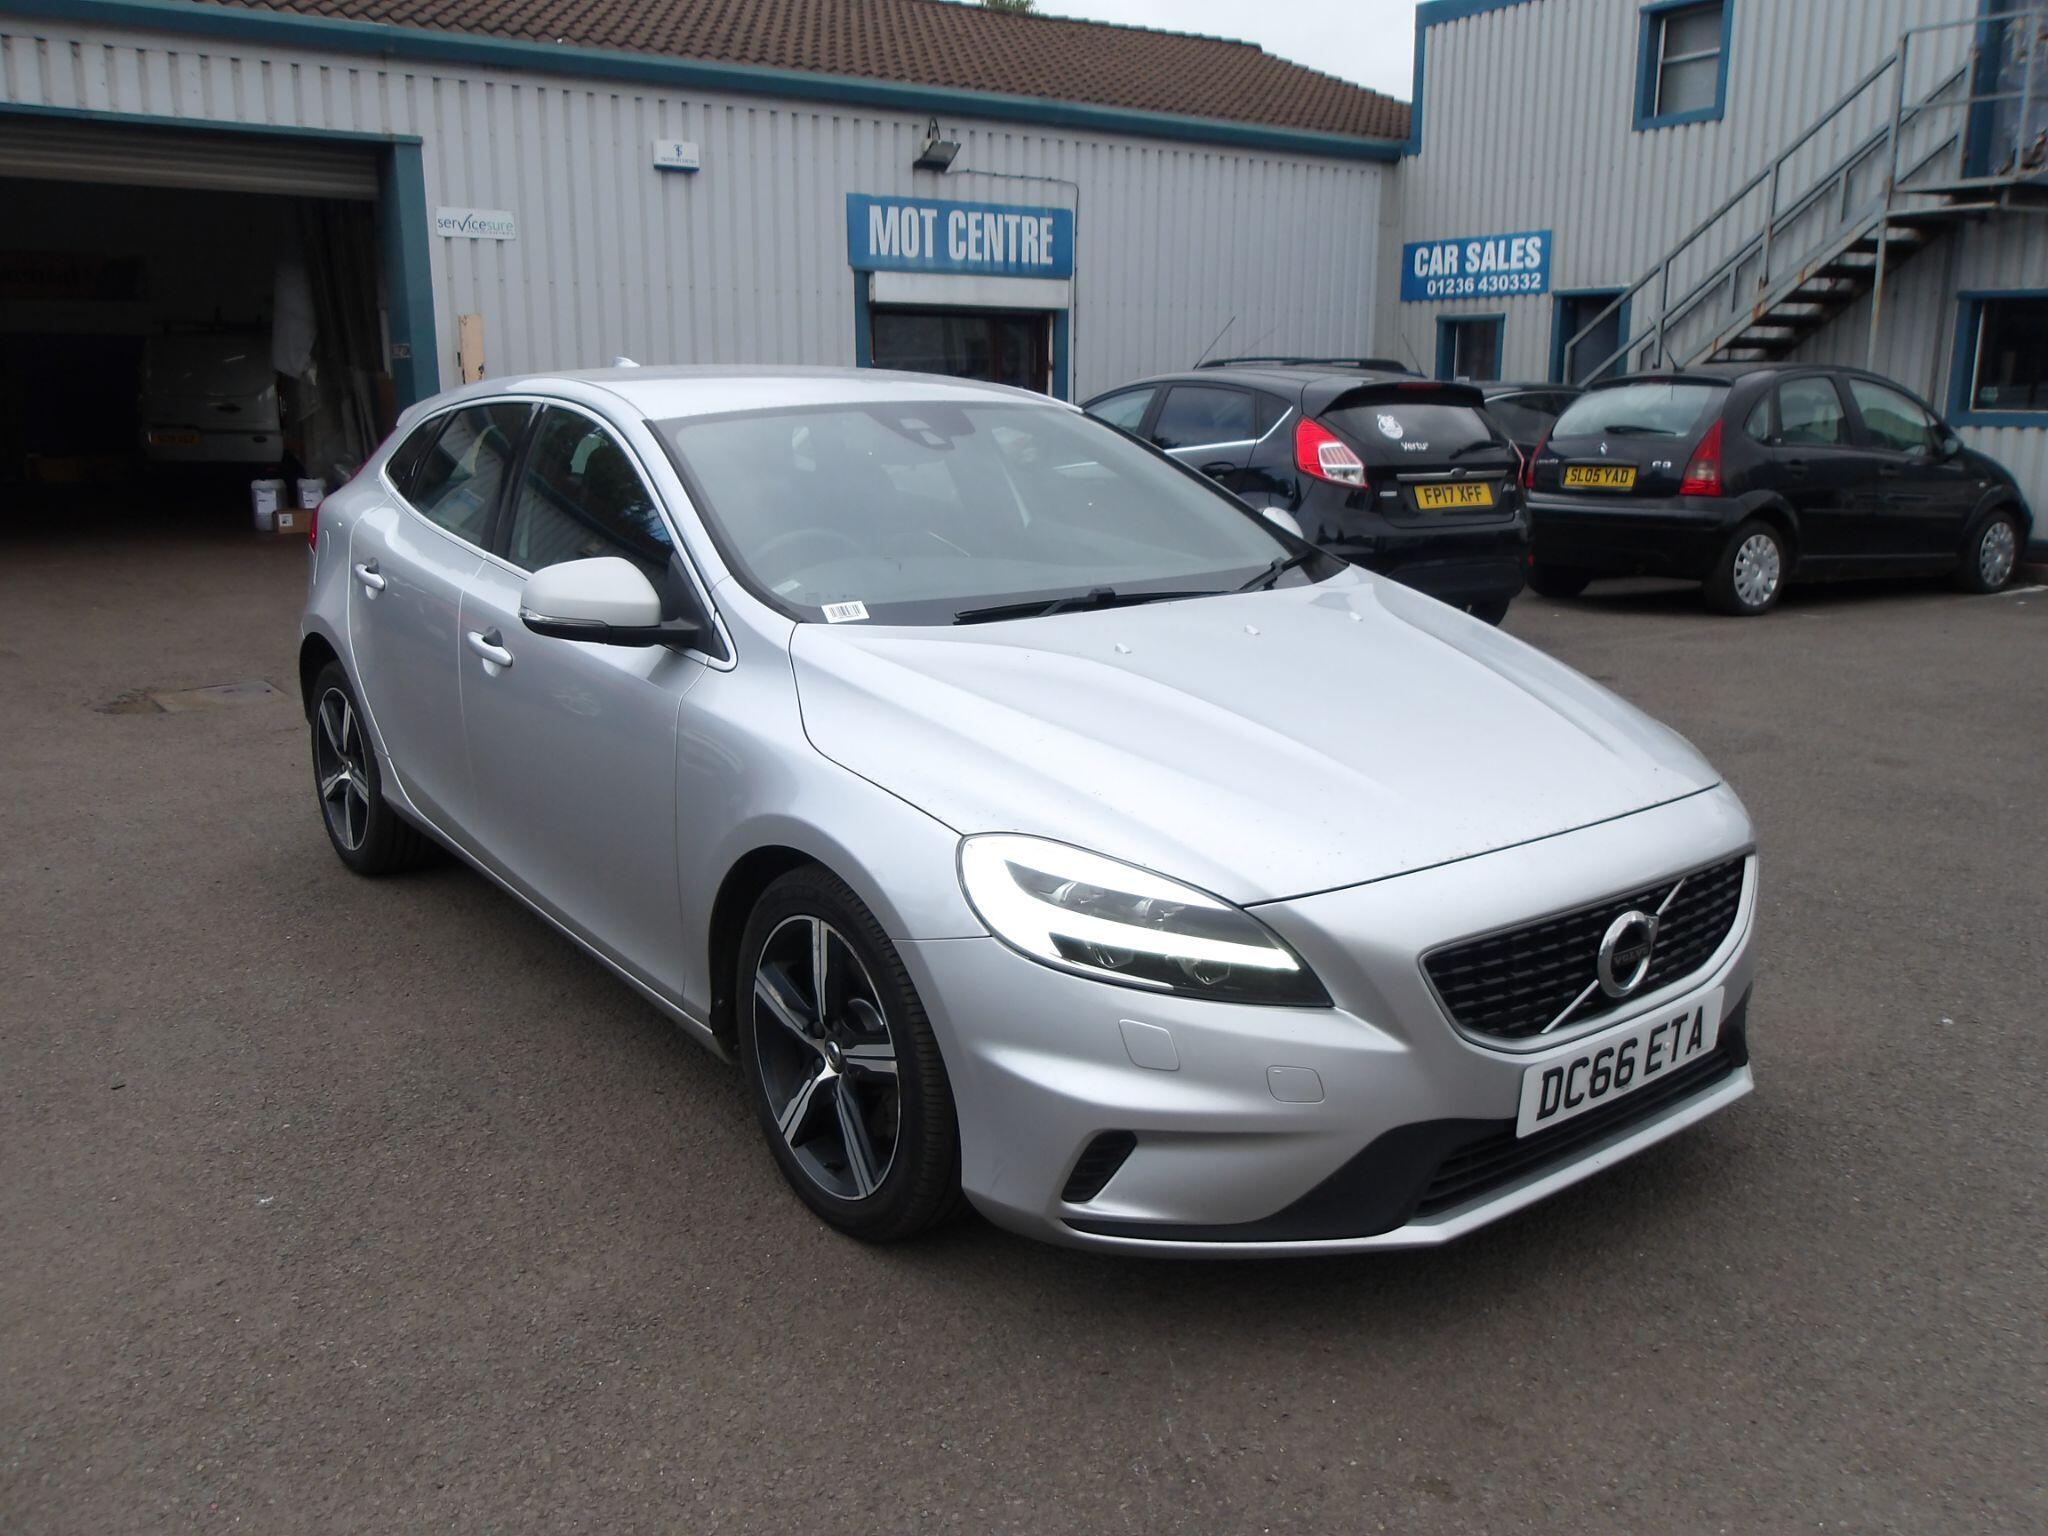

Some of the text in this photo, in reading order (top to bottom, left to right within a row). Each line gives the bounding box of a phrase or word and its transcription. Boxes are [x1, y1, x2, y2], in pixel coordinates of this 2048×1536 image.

[437, 213, 514, 232] servicesure
[869, 205, 1054, 265] MOT CENTRE
[1414, 236, 1542, 277] CAR SALES
[1427, 272, 1542, 295] 01236 430332
[1570, 466, 1629, 483] SL05 YAD
[1424, 485, 1455, 505] FP17
[1457, 485, 1482, 504] XFF
[1536, 1006, 1703, 1122] DC66 ETA
